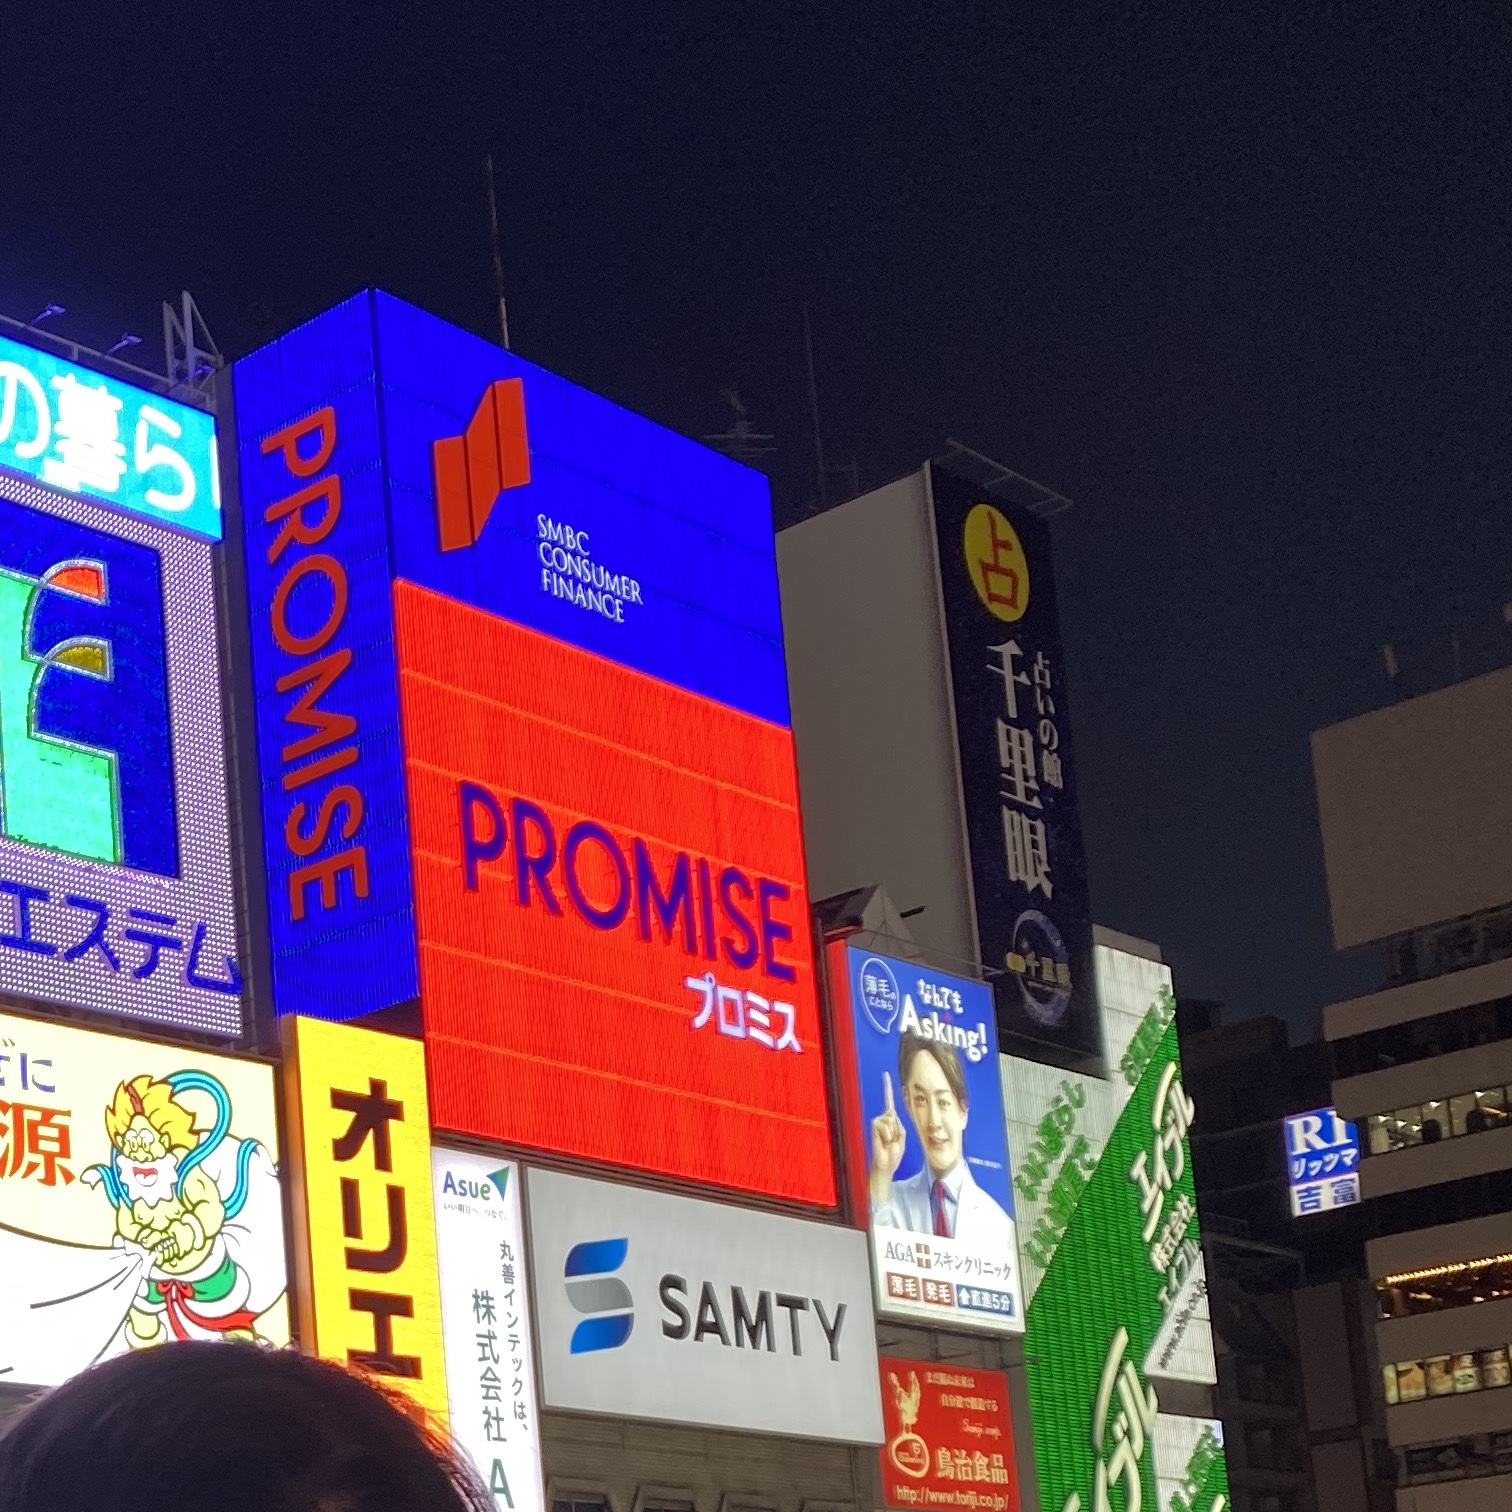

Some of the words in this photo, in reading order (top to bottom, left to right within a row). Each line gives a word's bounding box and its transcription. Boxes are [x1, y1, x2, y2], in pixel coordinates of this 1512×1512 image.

[538, 513, 590, 557] SMBC
[539, 541, 644, 605] CONSUMER
[979, 509, 1020, 610] 占
[541, 568, 625, 623] FINANCE
[261, 404, 369, 923] PROMISE
[986, 639, 1053, 899] 千里眼
[457, 779, 798, 982] PROMISE
[685, 973, 802, 1053] プロミス
[898, 993, 988, 1062] Asking!
[917, 978, 964, 1014] なんでも
[442, 1170, 492, 1201] Asue
[1129, 1079, 1195, 1214] エイブル
[330, 1076, 423, 1380] オリエ
[885, 1240, 916, 1264] AGA
[933, 1251, 1012, 1281] スキンクリニック
[499, 1239, 529, 1432] 丸善インテックは、
[658, 1273, 848, 1362] SAMTY
[471, 1288, 507, 1443] 株式会社
